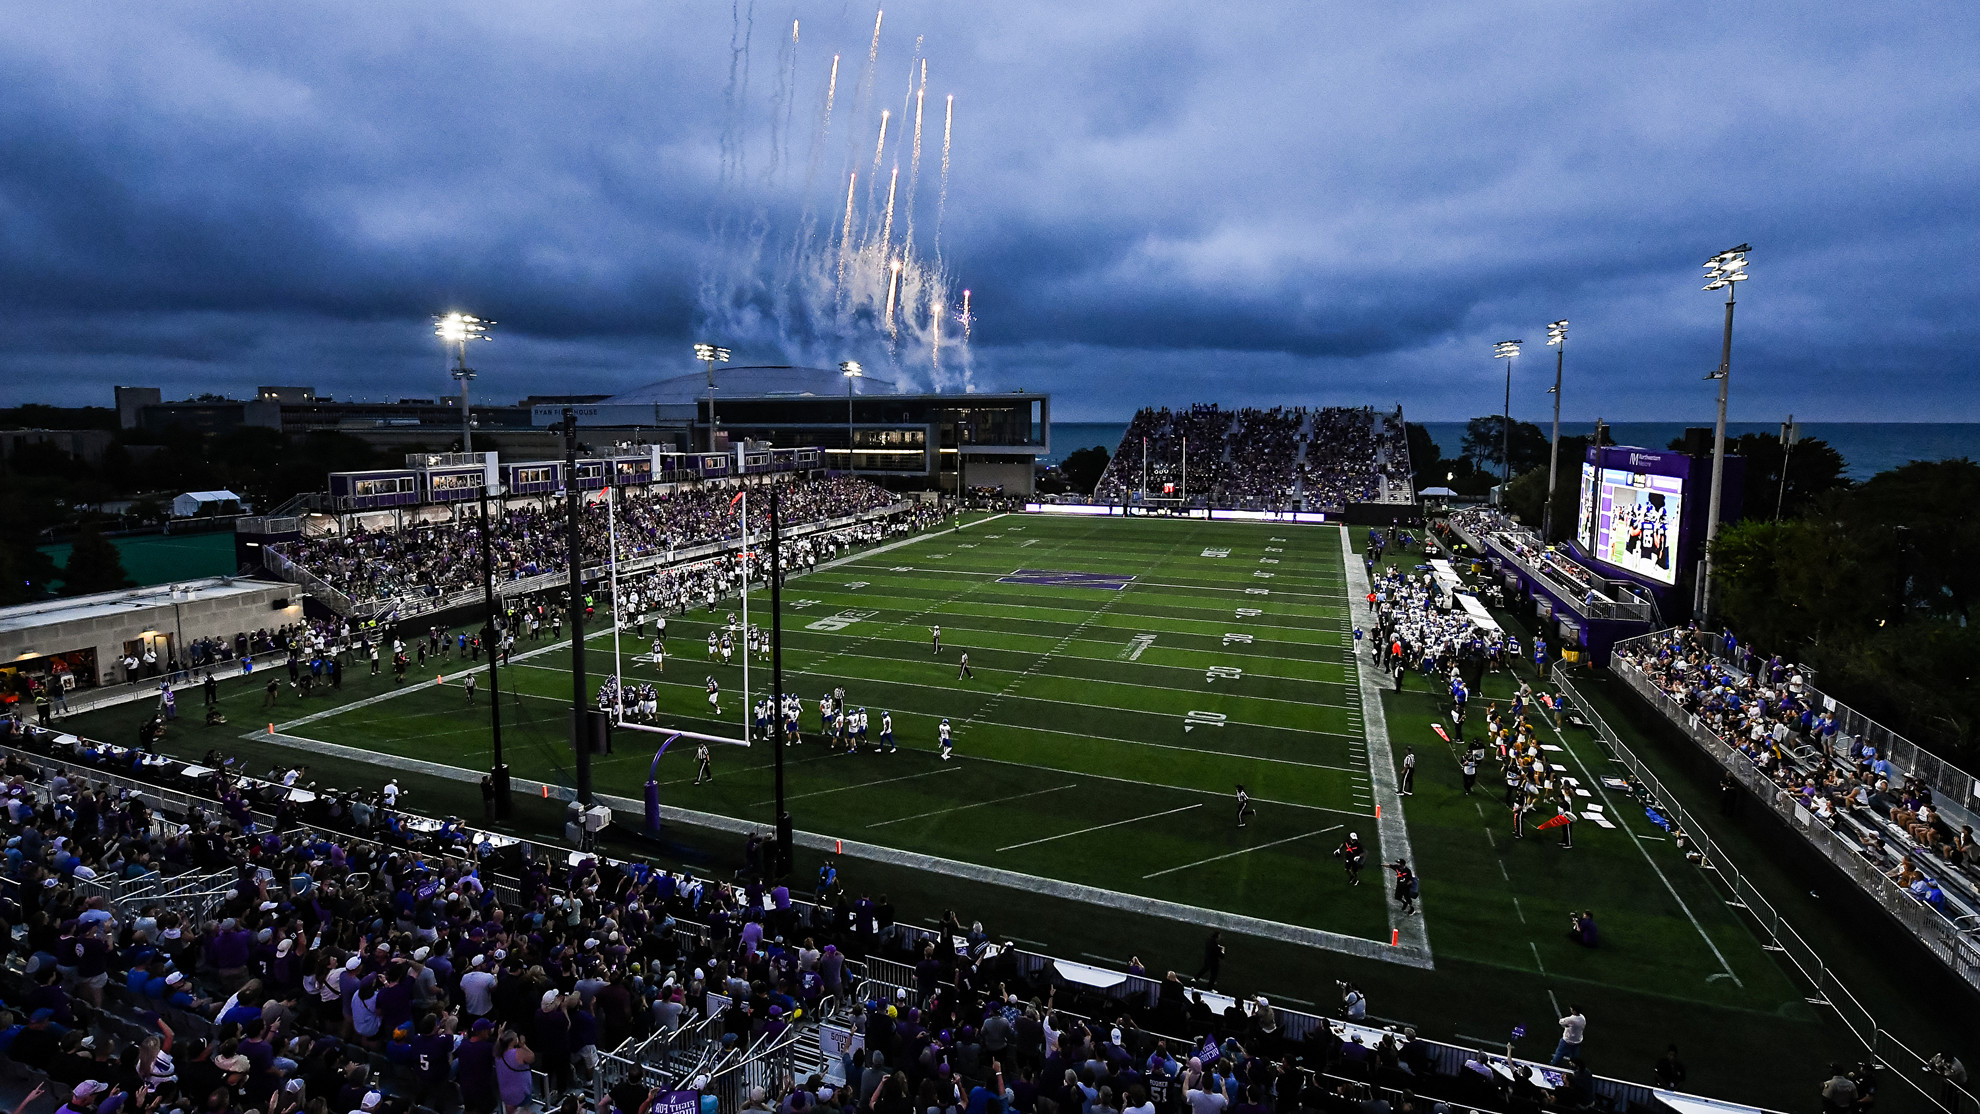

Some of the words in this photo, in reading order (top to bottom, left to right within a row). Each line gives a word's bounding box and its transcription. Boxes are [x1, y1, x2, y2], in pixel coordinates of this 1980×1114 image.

[1184, 710, 1227, 728] 10
[259, 961, 267, 974] 7
[420, 1053, 430, 1071] 5
[1150, 1086, 1167, 1102] 51
